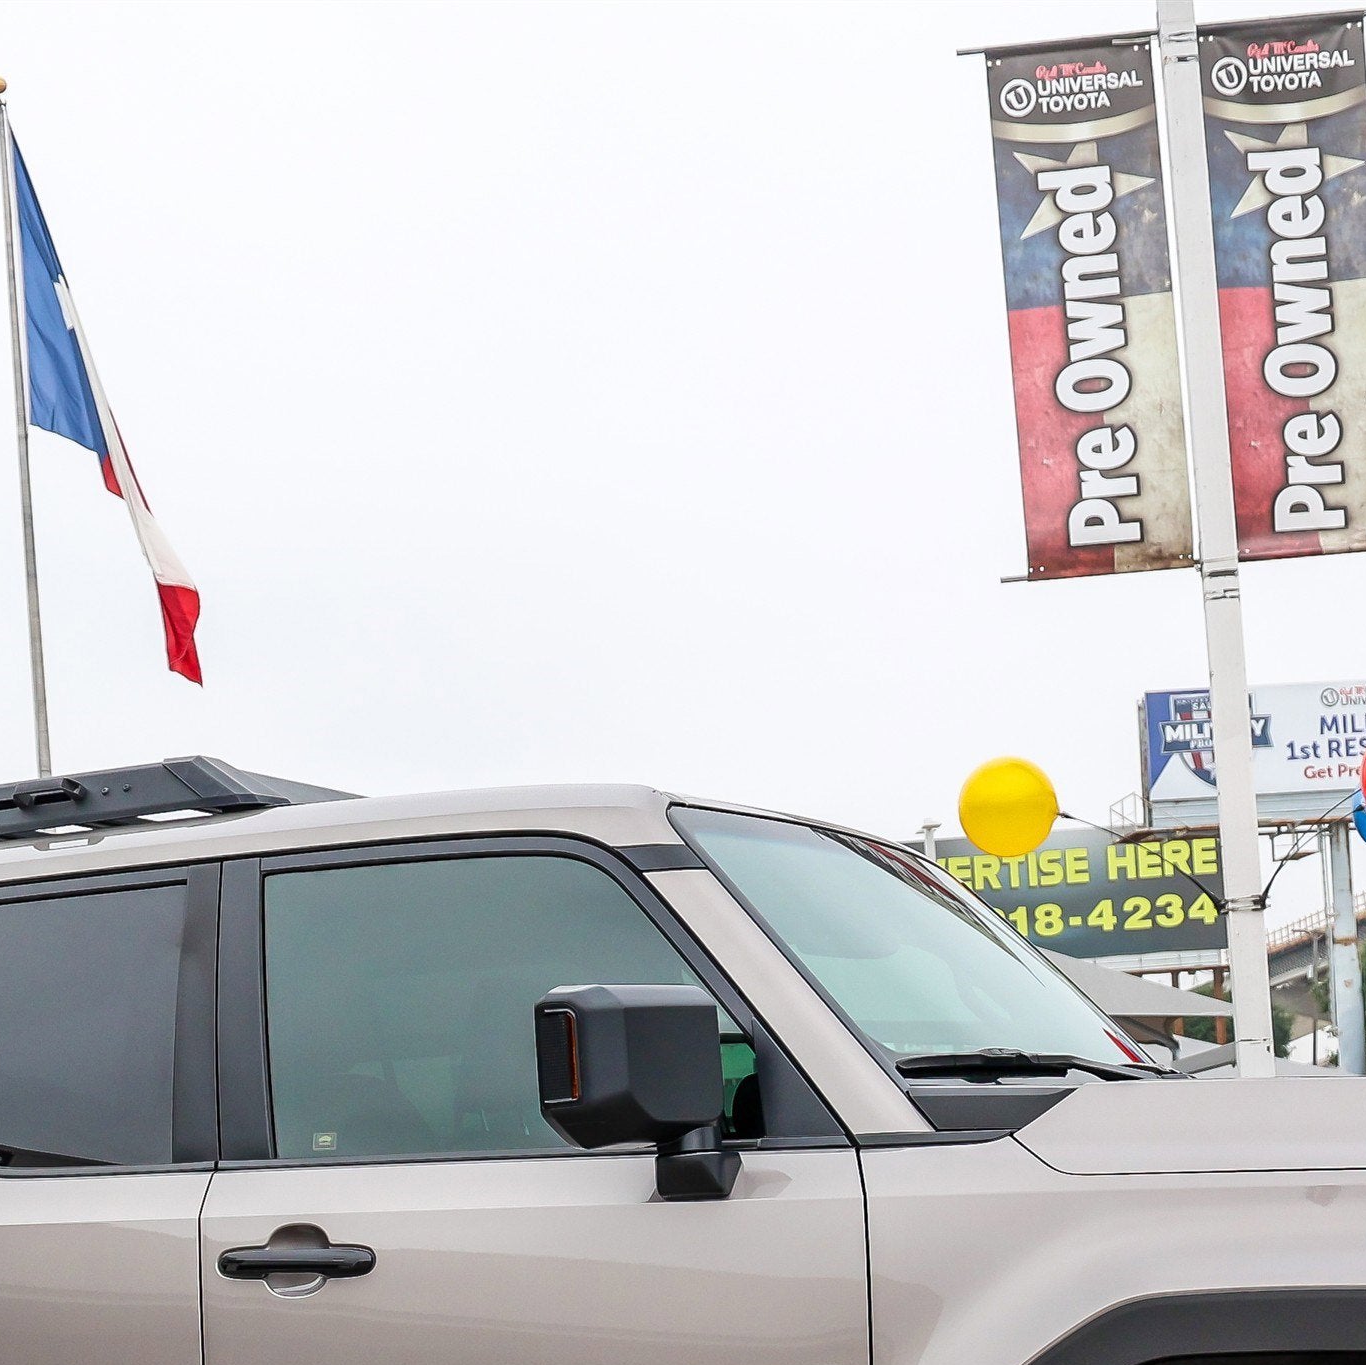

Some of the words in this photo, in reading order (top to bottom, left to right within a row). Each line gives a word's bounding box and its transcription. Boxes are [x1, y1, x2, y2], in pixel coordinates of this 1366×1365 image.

[1248, 50, 1355, 75] UNIVERSAL
[1037, 70, 1144, 96] UNIVERSAL
[1249, 71, 1322, 93] TOYOTA
[1038, 92, 1111, 114] TOYOTA
[1247, 147, 1337, 397] Owned
[1037, 164, 1130, 413] Owned
[1275, 411, 1346, 532] Pre
[1067, 424, 1144, 548] Pre
[1165, 719, 1265, 742] MILIY
[1286, 740, 1321, 760] 1st
[1304, 764, 1333, 779] Get
[937, 848, 1090, 890] ERTISE
[1107, 838, 1218, 880] HERE
[993, 893, 1219, 937] 18-4234
